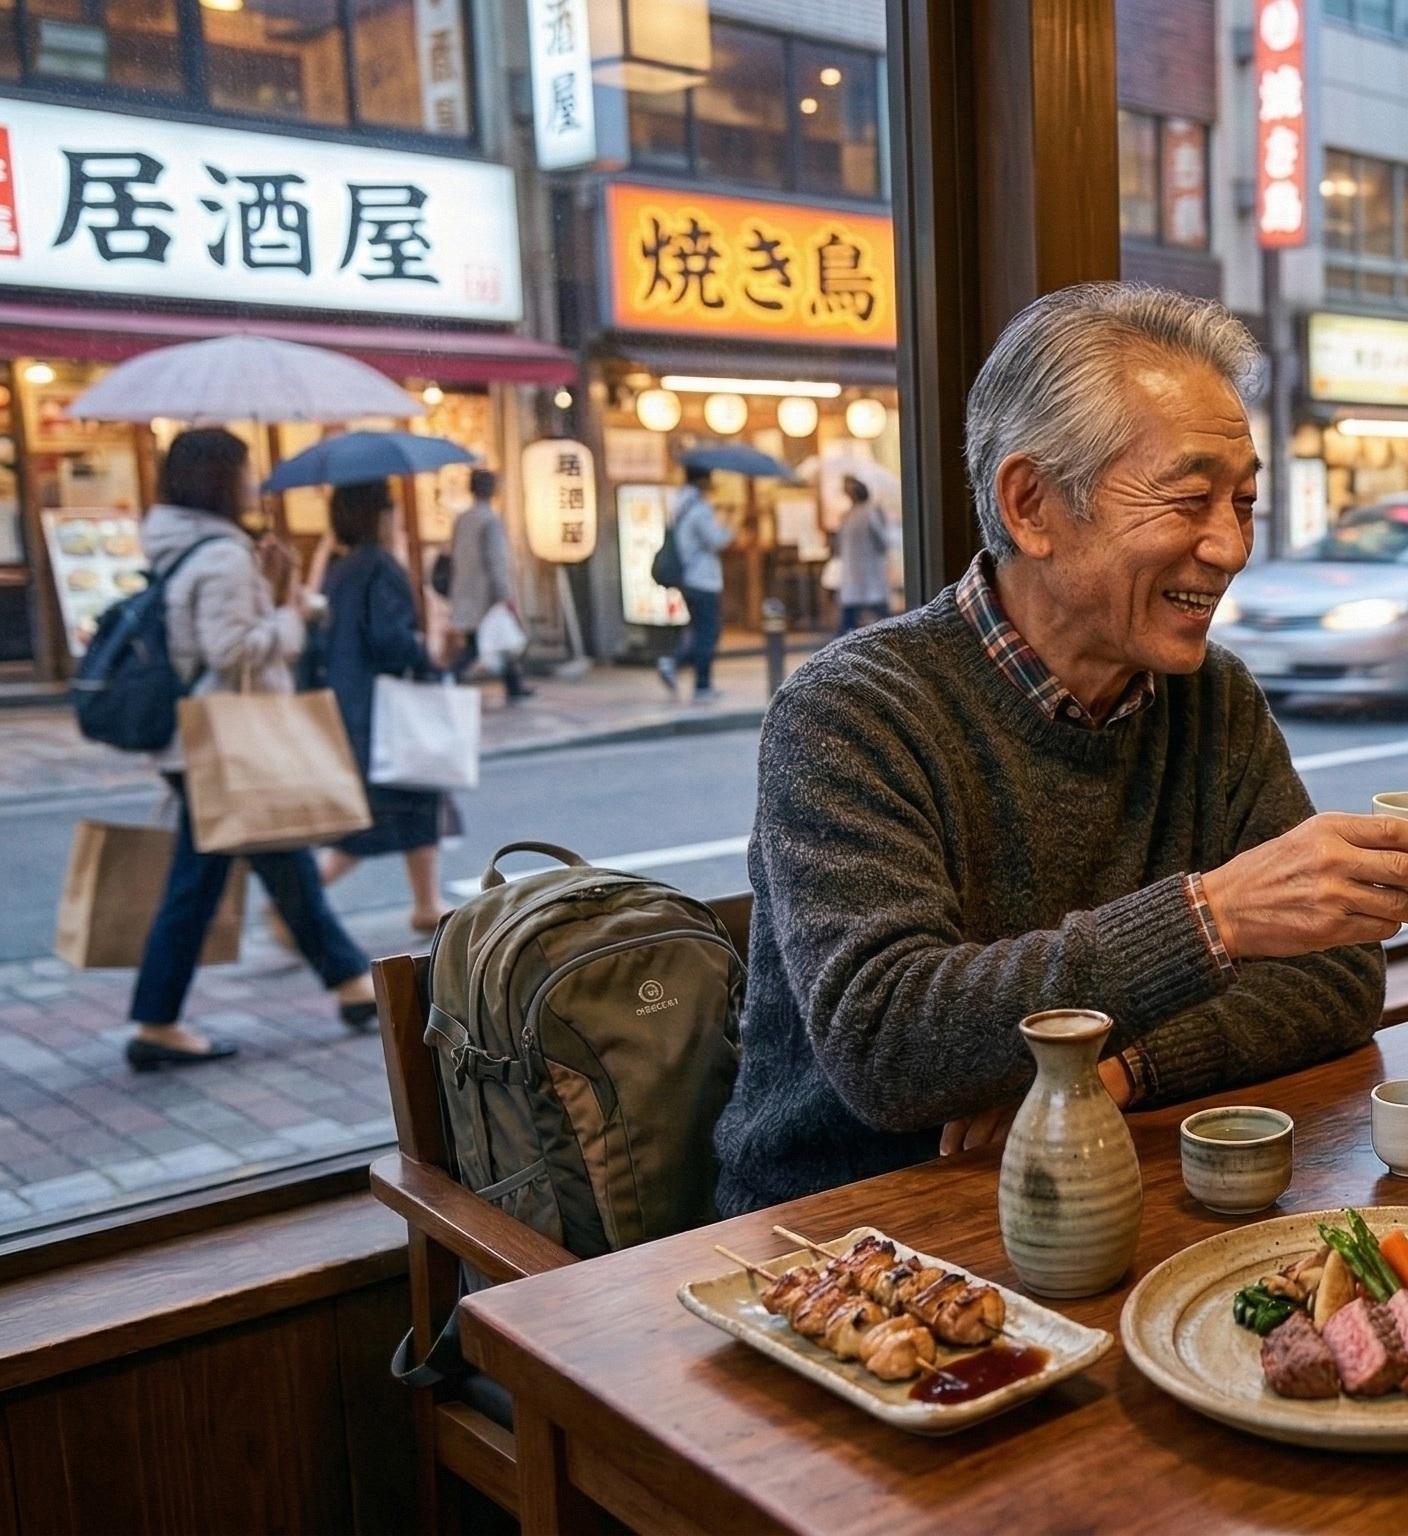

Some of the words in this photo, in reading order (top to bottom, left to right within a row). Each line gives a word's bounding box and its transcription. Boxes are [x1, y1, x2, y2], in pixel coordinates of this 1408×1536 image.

[52, 149, 440, 285] 居酒屋
[641, 218, 875, 320] 焼き鳥
[555, 454, 584, 543] 居酒屋
